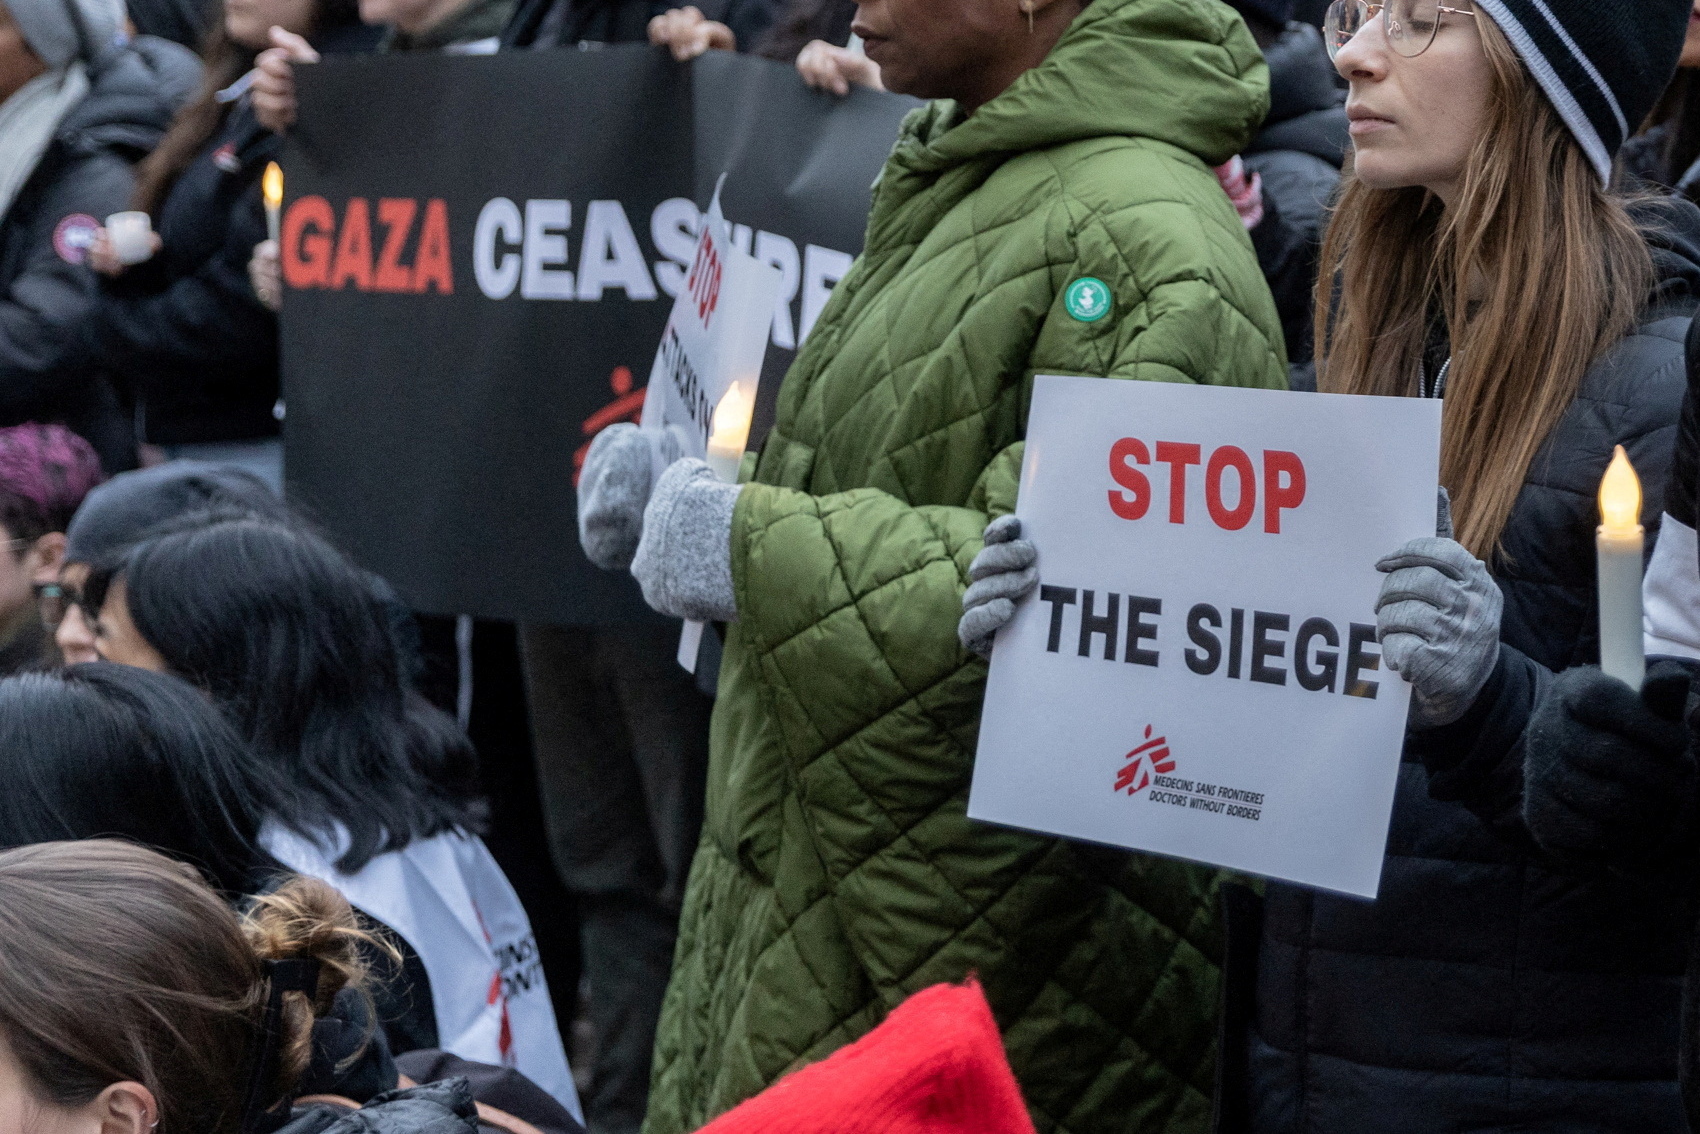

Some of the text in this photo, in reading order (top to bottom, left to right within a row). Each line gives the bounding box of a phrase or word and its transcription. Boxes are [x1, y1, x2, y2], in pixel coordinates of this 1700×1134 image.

[281, 195, 454, 296] GAZA
[687, 225, 723, 330] STOP
[1107, 437, 1307, 534] STOP
[1040, 584, 1382, 700] THE SIEGE
[1149, 790, 1262, 821] DOCTORS WITHOUT BORDERS
[1153, 775, 1265, 805] MEDECINS SANS FRONTIERES
